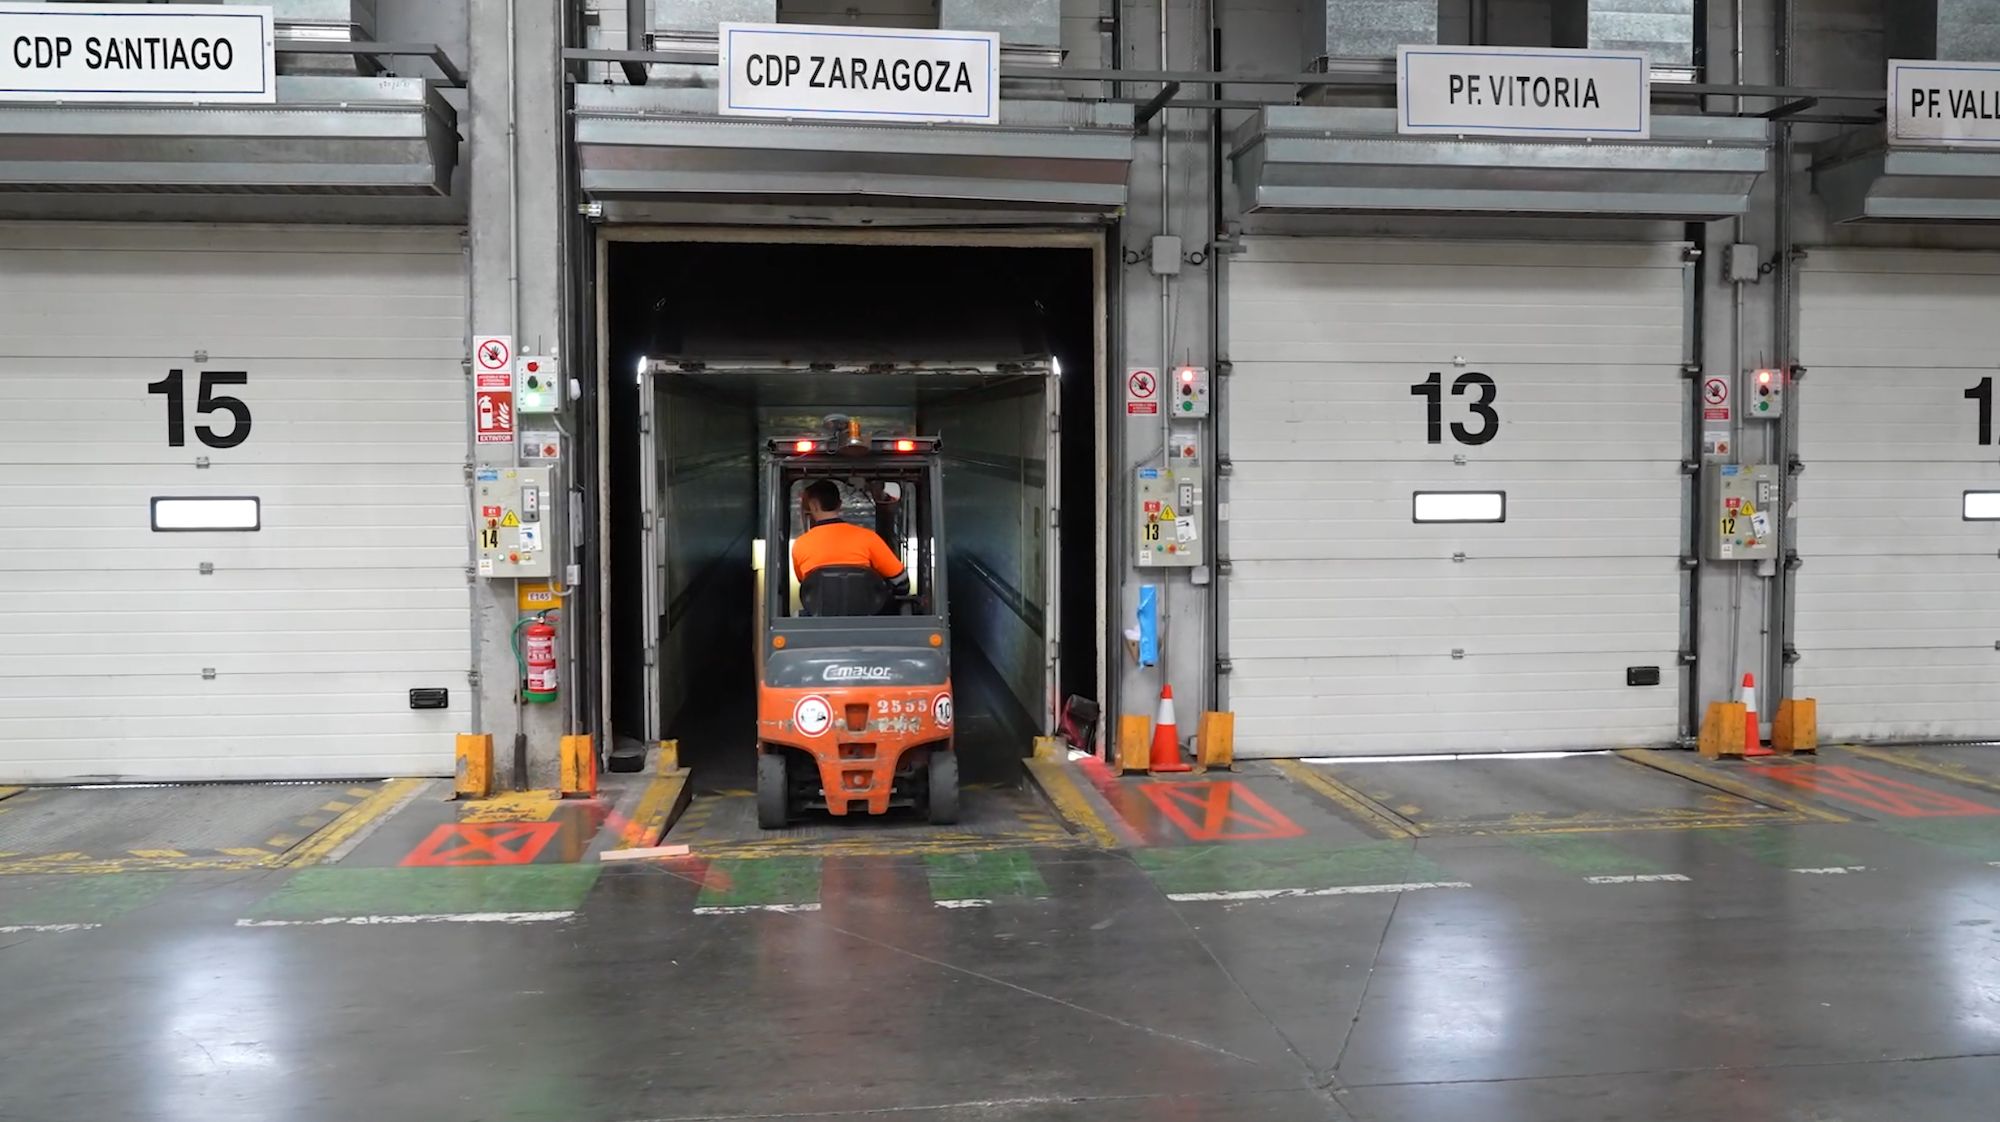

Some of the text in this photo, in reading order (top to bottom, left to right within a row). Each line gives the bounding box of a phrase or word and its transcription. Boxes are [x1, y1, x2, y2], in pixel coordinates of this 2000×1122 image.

[13, 35, 233, 71] CDP SANTIAGO
[746, 53, 973, 93] CDP ZARAGOZA
[1449, 74, 1600, 109] PF. VITORIA
[1911, 88, 1941, 119] PF.
[148, 369, 252, 449] 15
[1410, 372, 1499, 446] 13
[1964, 376, 2000, 446] 1
[481, 529, 498, 548] 14
[1145, 523, 1160, 540] 13
[1722, 518, 1735, 535] 12
[530, 592, 550, 601] E145
[938, 702, 951, 720] 10
